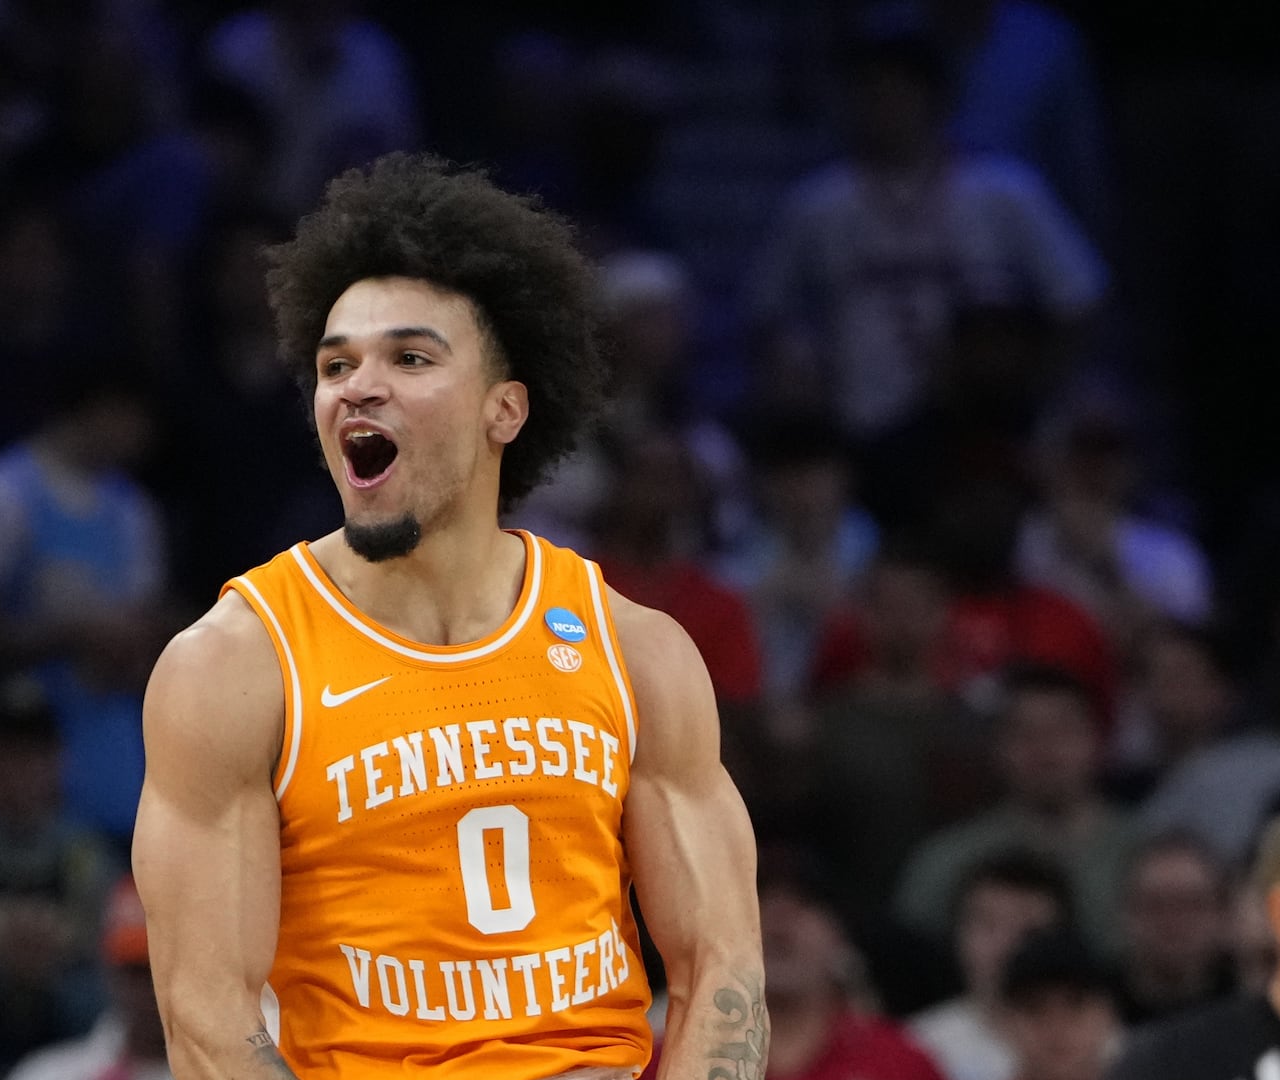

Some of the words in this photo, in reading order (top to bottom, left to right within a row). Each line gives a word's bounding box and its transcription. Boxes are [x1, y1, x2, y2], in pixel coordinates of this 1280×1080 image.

[550, 647, 580, 670] SEC
[552, 622, 585, 634] NCAA
[326, 716, 620, 823] TENNESSEE
[457, 805, 536, 935] 0
[339, 915, 629, 1022] VOLUNTEERS
